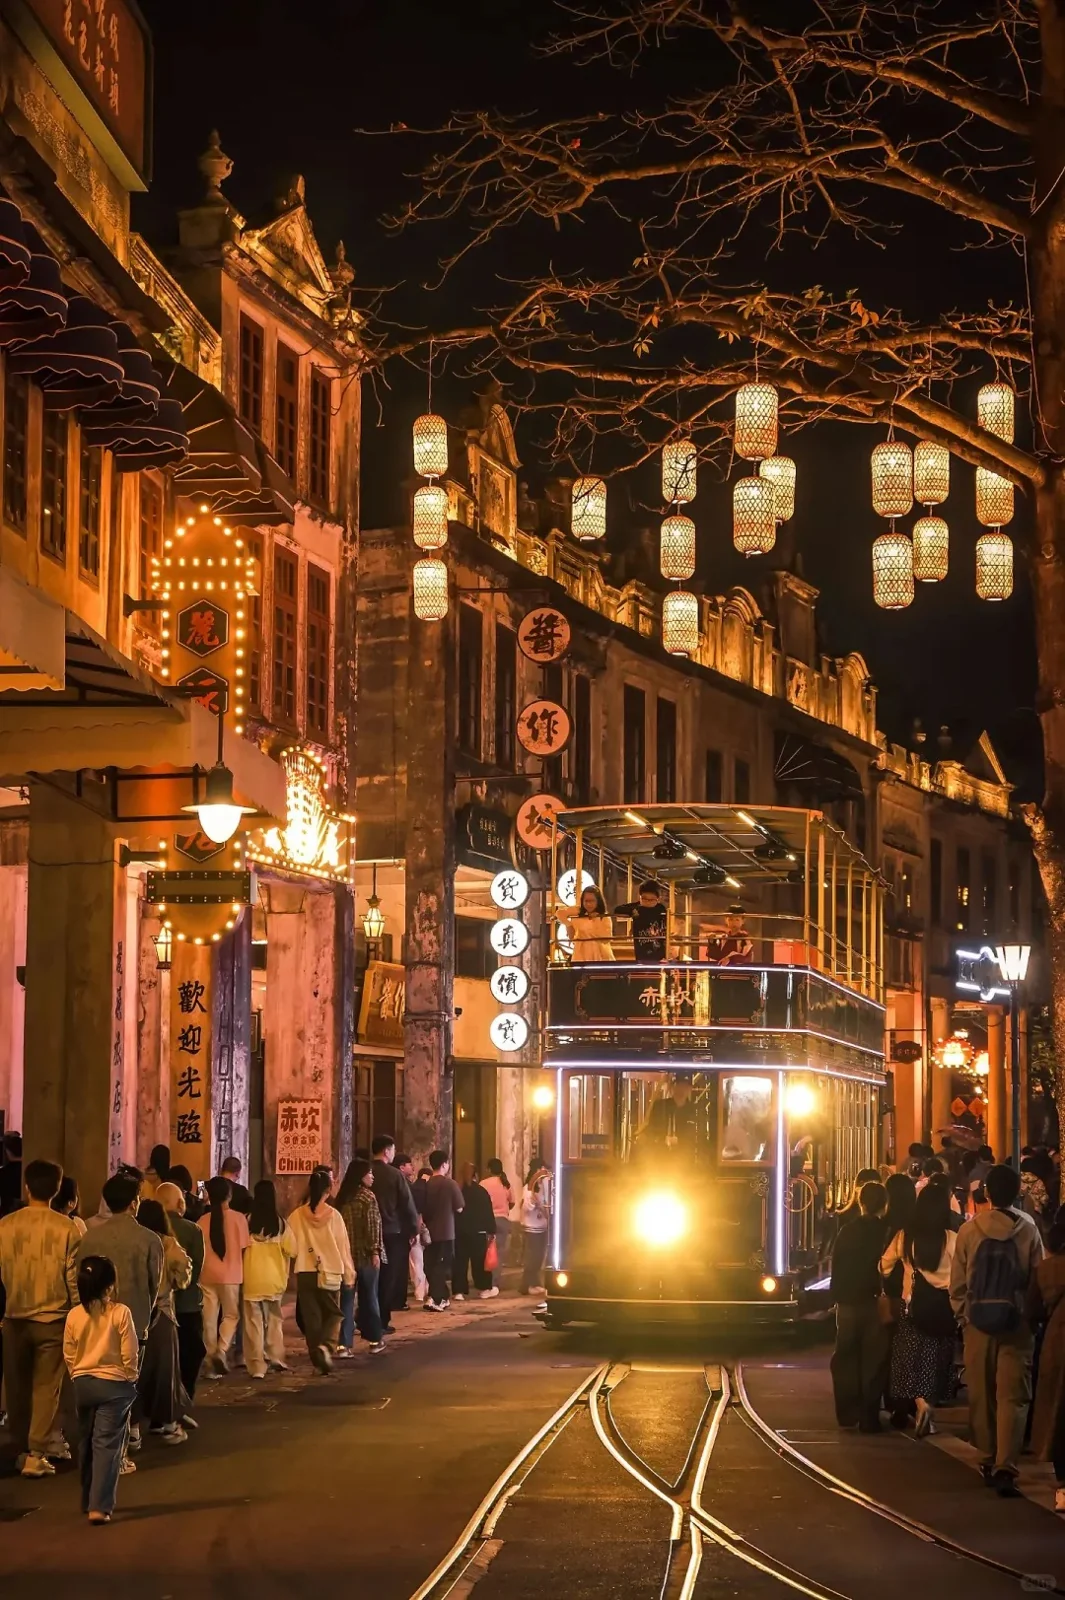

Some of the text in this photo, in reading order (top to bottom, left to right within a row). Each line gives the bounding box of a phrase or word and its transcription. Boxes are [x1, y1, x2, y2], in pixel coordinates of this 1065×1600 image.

[497, 875, 519, 1044] 貨真價實
[177, 980, 207, 1144] 歡迎光臨
[280, 1106, 320, 1132] 赤坎
